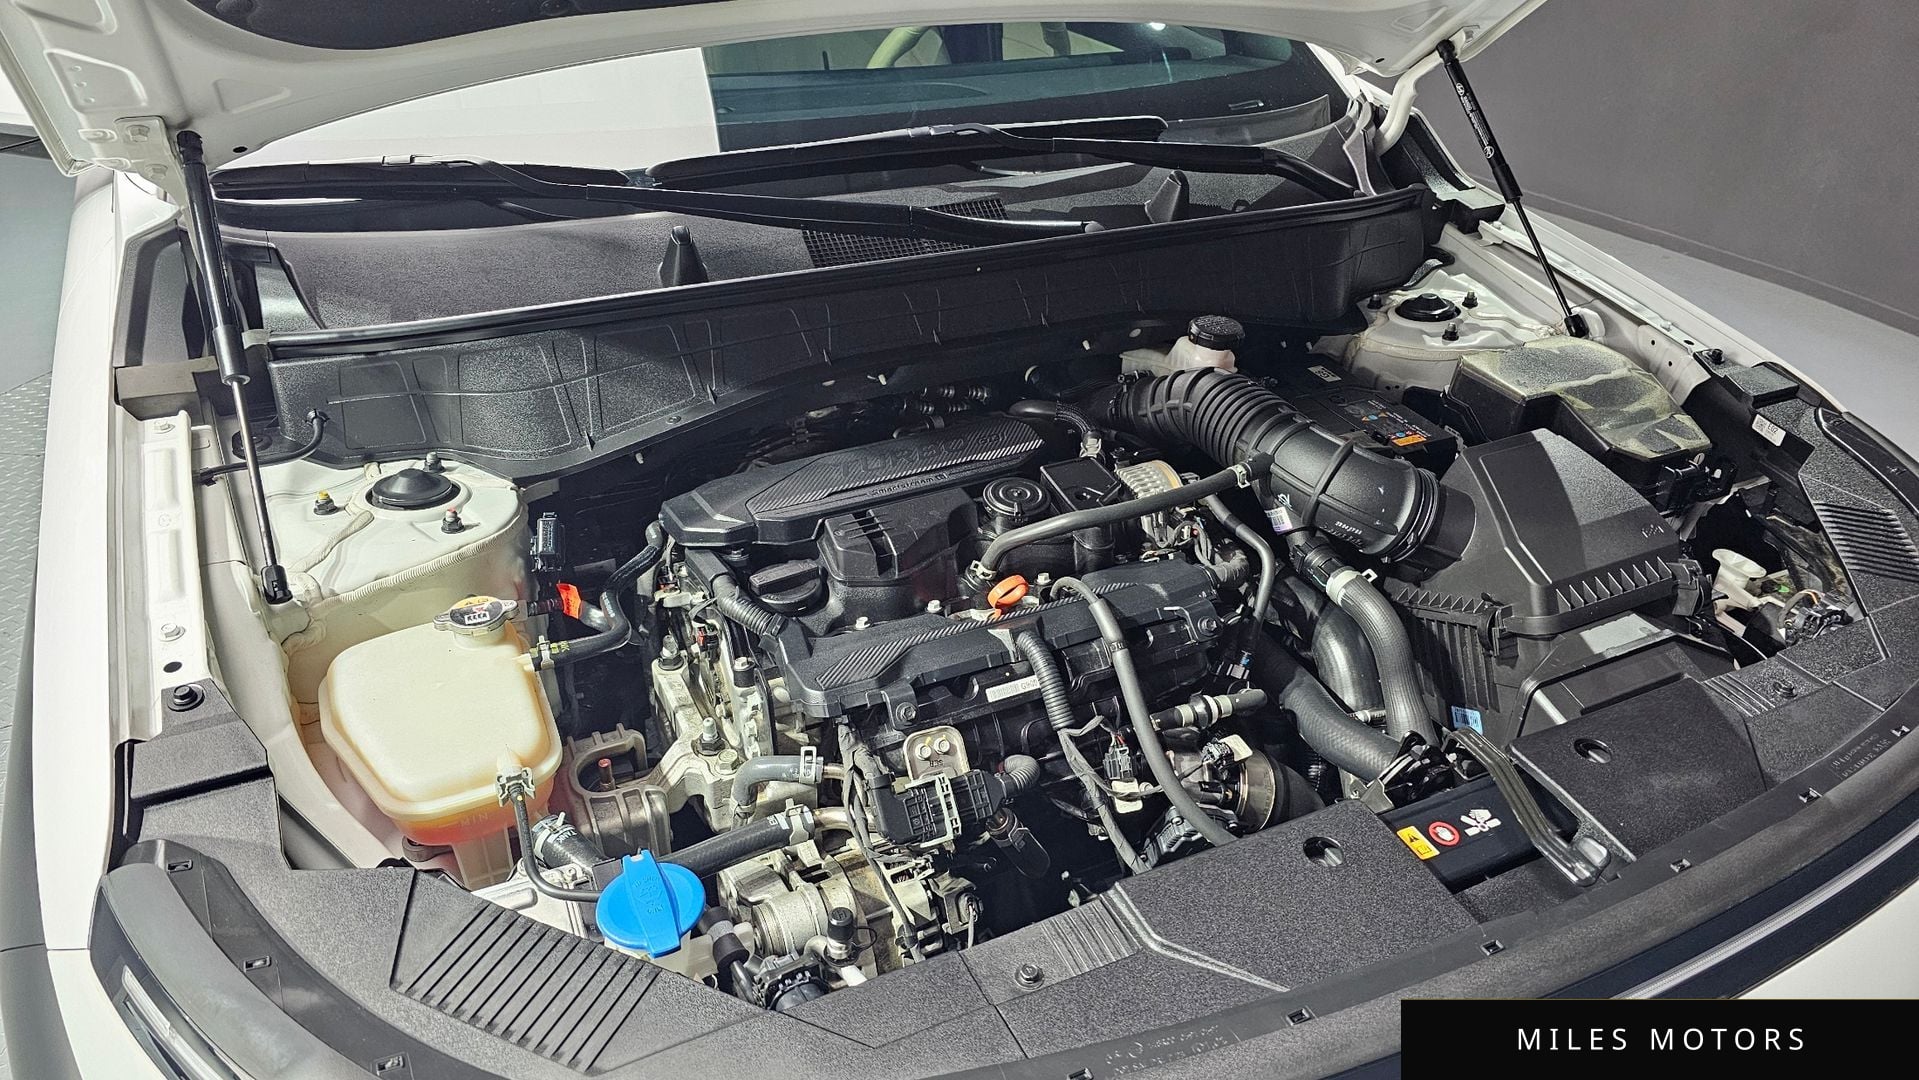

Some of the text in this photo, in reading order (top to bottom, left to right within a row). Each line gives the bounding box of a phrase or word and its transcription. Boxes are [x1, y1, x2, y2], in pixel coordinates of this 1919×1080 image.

[834, 436, 965, 477] TURBO
[870, 477, 934, 496] Smartstream
[460, 812, 489, 827] MIN
[557, 829, 578, 844] TANK
